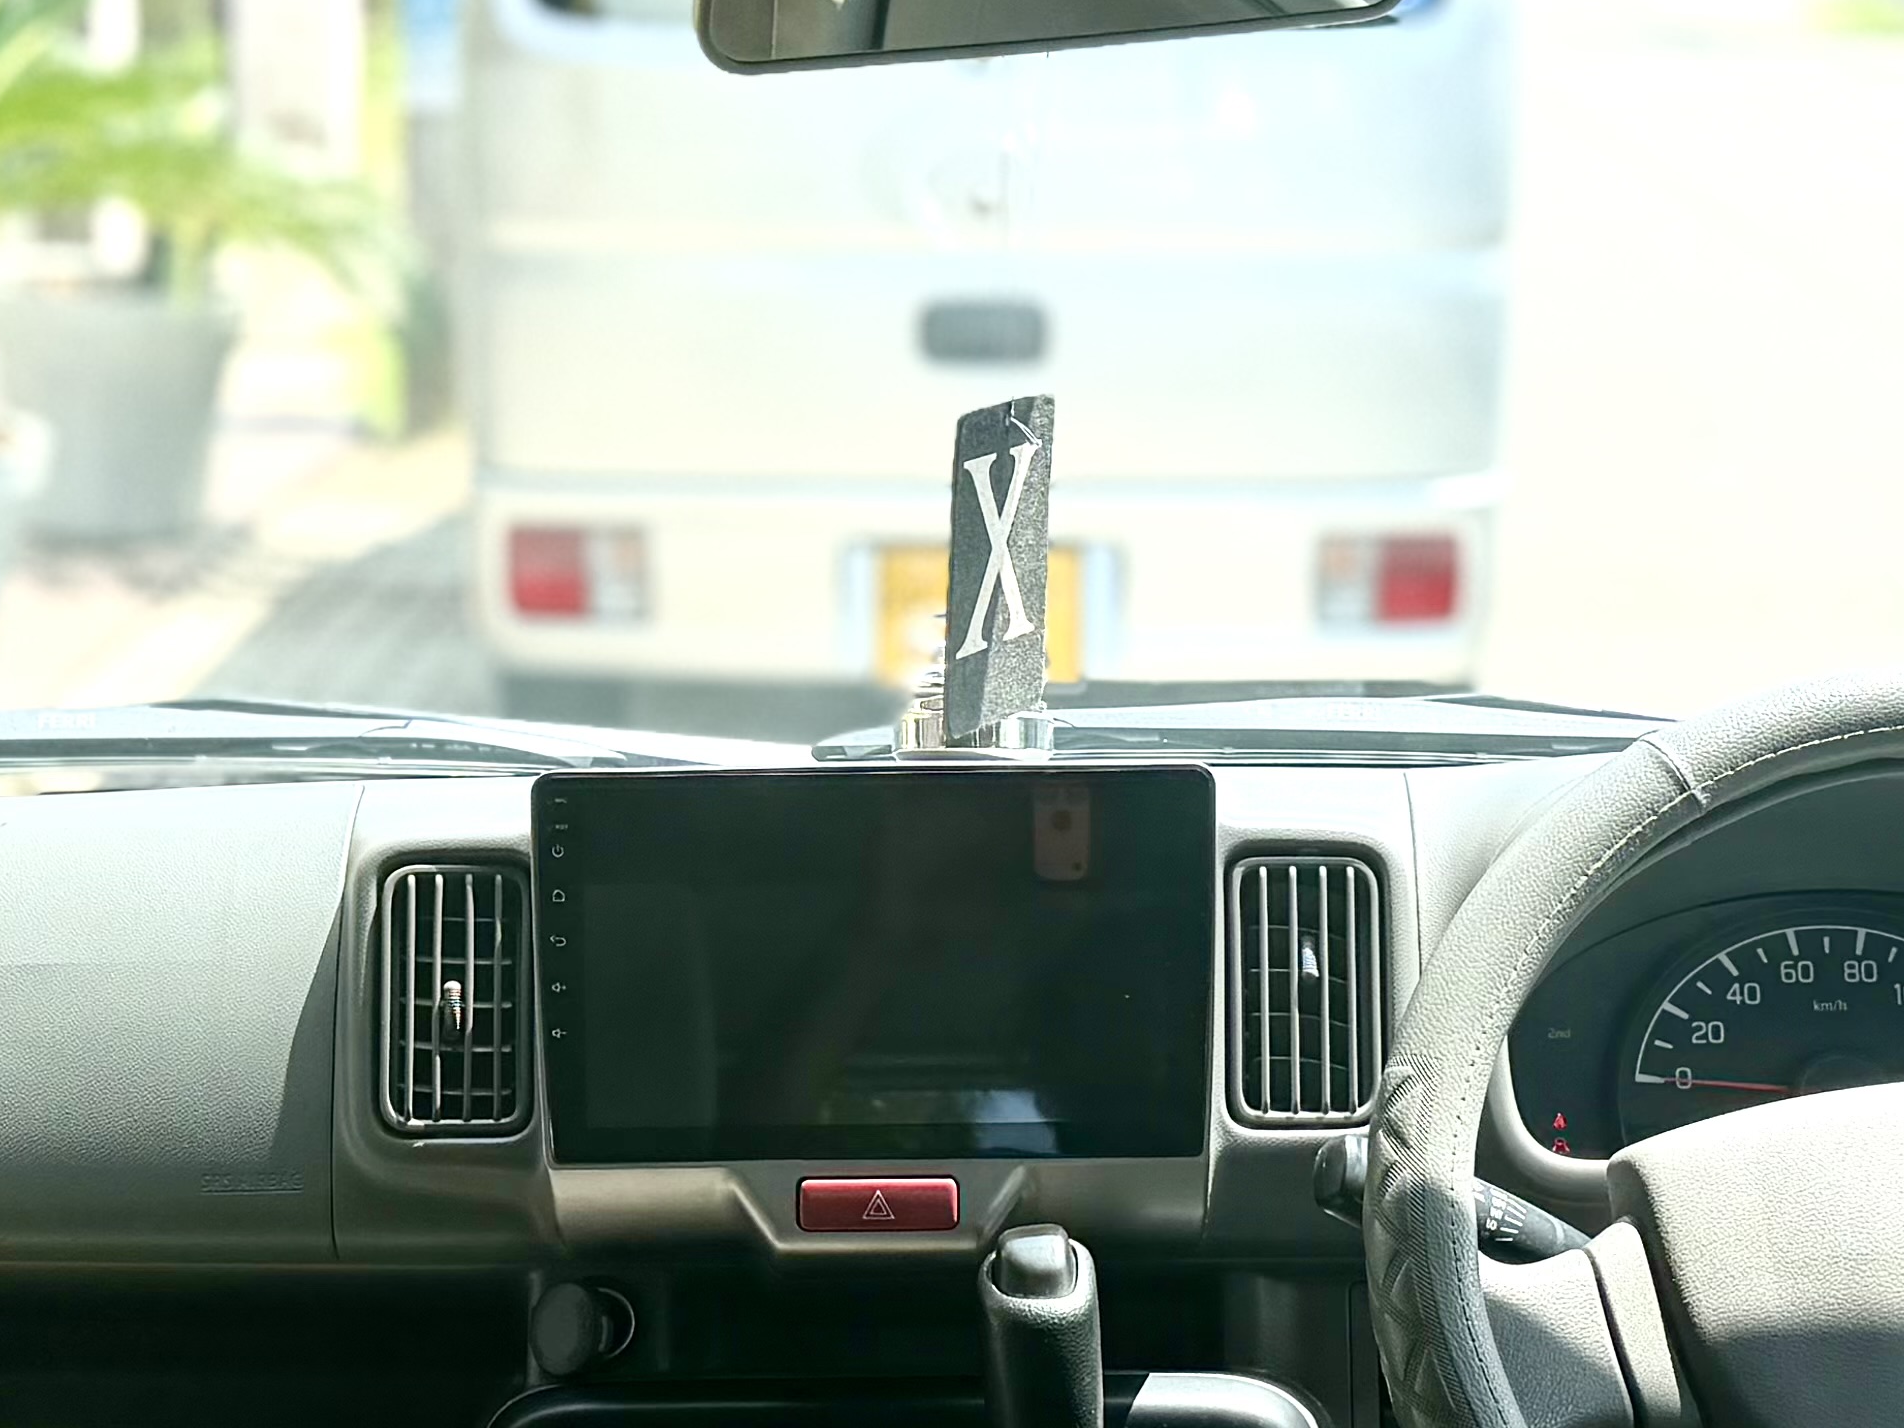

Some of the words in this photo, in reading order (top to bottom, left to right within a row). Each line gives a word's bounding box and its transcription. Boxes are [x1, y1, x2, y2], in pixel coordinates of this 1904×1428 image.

[955, 438, 1043, 660] X
[1779, 959, 1815, 984] 60
[1843, 959, 1878, 983] 80
[1725, 982, 1762, 1006] 40
[1812, 997, 1848, 1013] km/h
[1690, 1021, 1726, 1045] 20
[1674, 1066, 1693, 1090] 0
